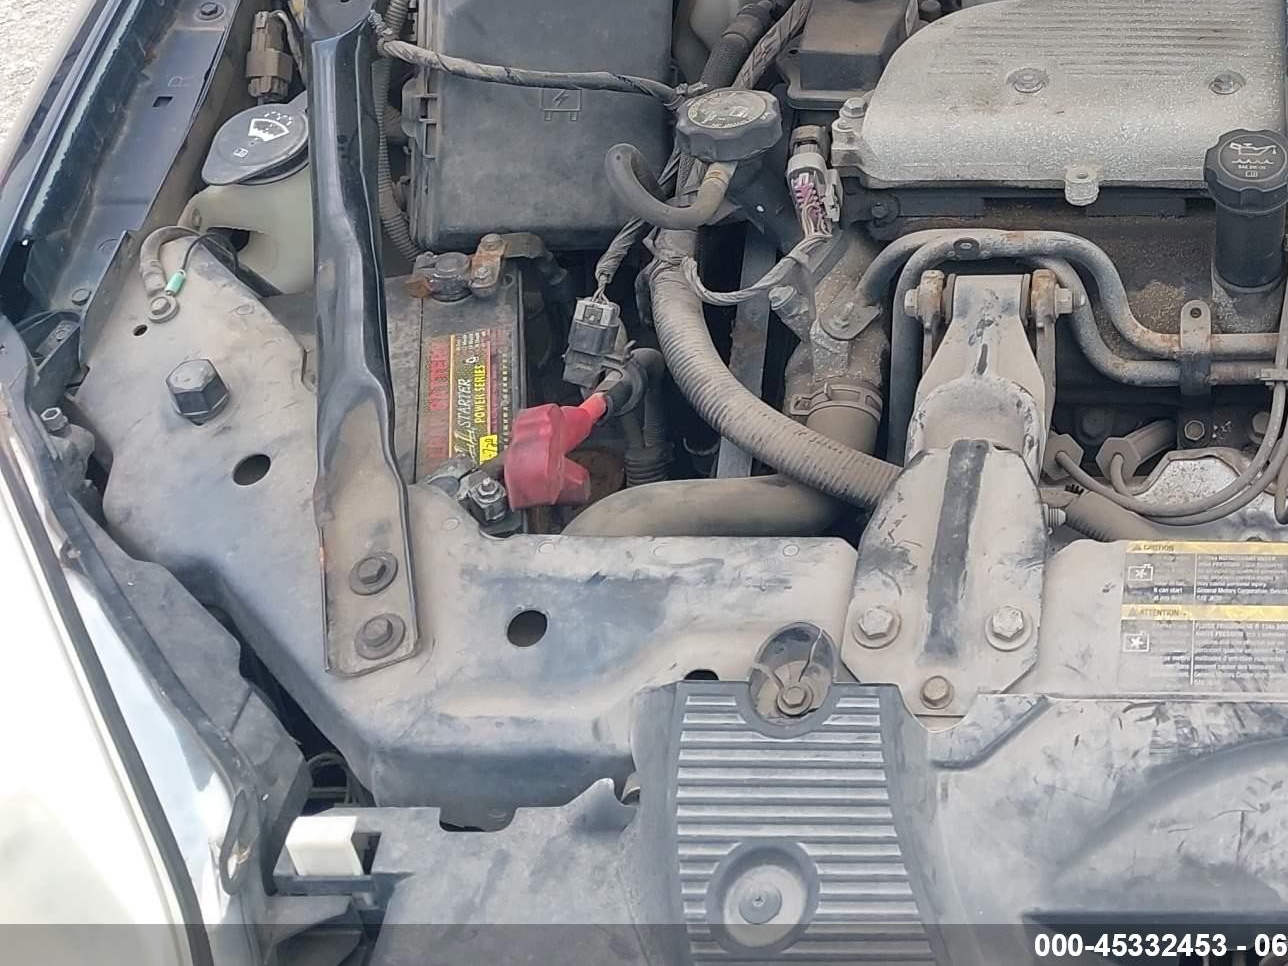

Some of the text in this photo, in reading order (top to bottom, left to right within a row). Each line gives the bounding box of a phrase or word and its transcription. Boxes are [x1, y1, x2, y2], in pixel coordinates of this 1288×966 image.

[456, 378, 472, 428] STARTER
[474, 364, 486, 423] POWER SERIES
[1140, 609, 1180, 617] ATTENTION
